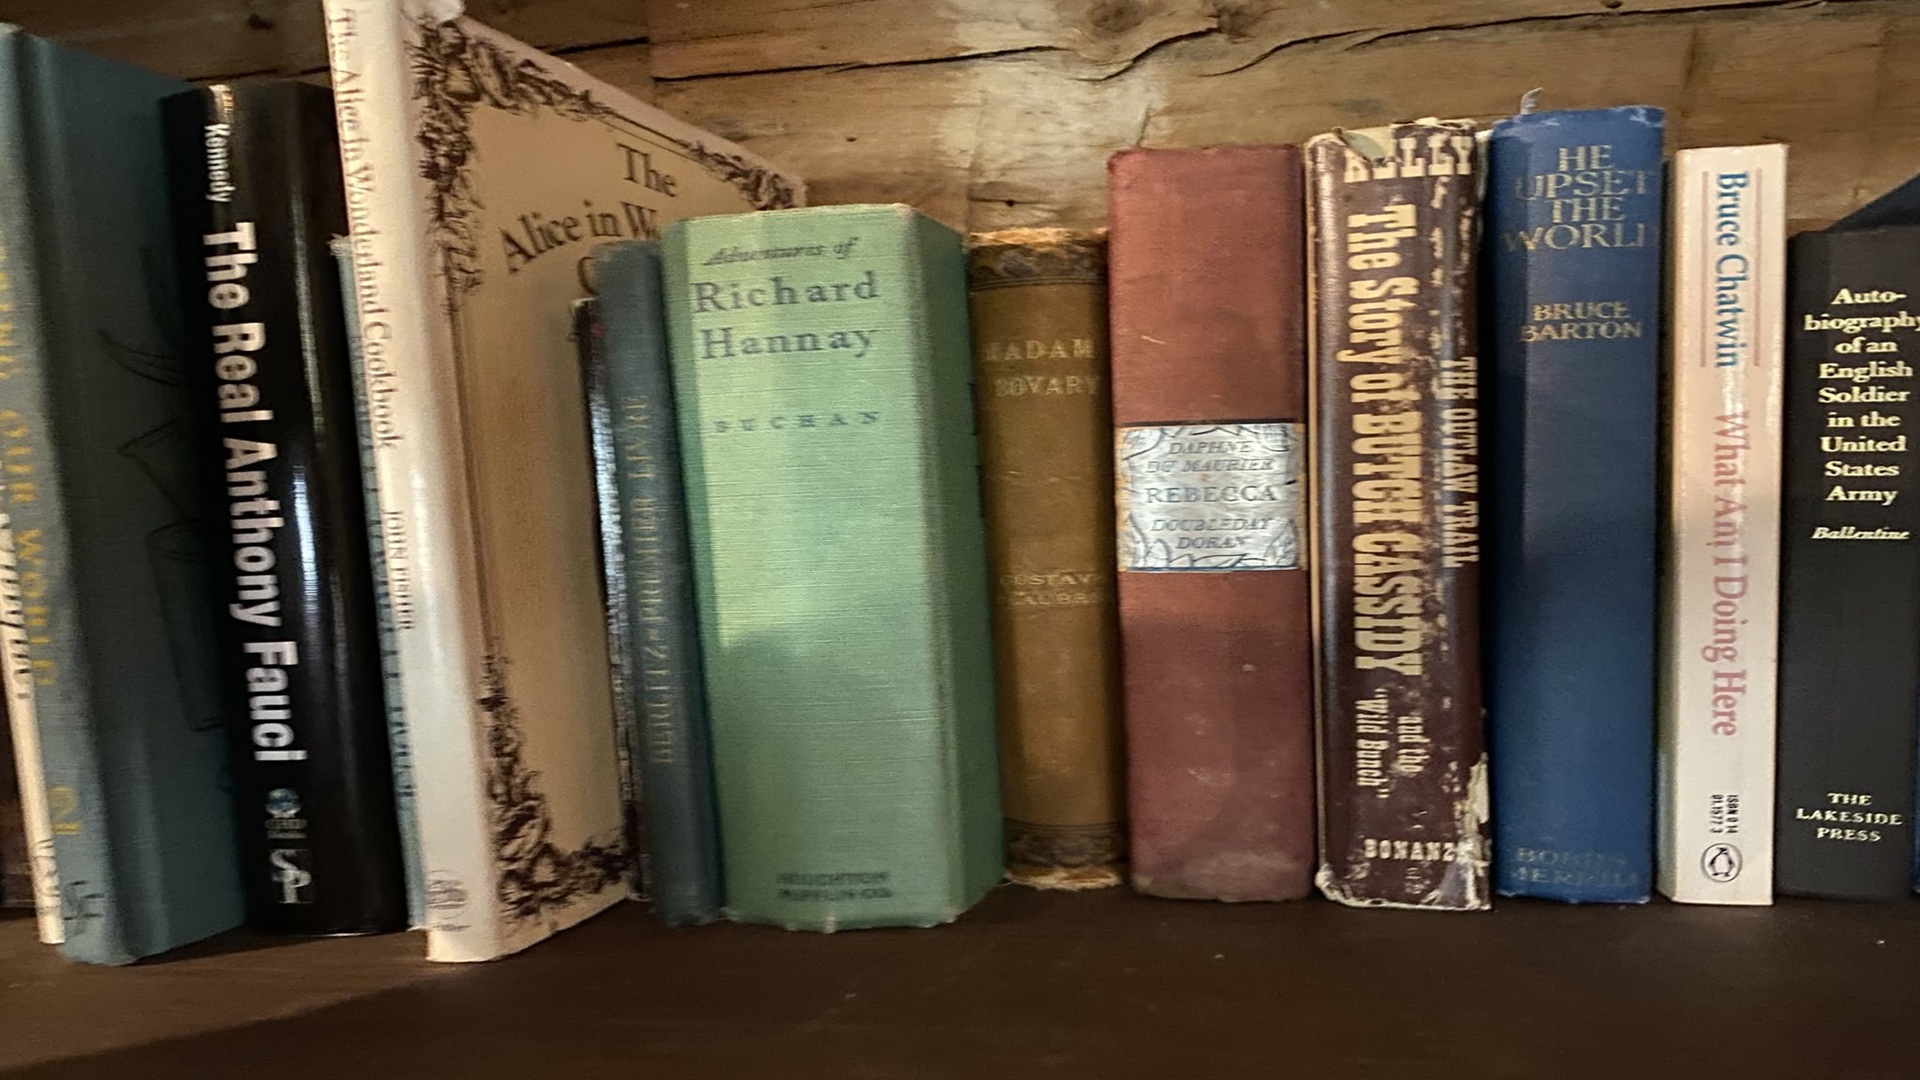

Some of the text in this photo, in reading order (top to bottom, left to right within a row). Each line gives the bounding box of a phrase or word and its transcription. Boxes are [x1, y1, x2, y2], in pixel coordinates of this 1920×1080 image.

[203, 124, 237, 203] Kennedy
[616, 142, 678, 198] The
[1558, 144, 1614, 172] HE
[1545, 196, 1628, 224] THE
[345, 162, 390, 313] Wonderland
[500, 211, 582, 275] Alice
[582, 199, 623, 239] in
[831, 236, 861, 260] of
[1347, 204, 1417, 270] The
[202, 221, 259, 311] The
[1714, 170, 1750, 369] Bruce Chatwin
[690, 270, 881, 314] Richard
[1831, 288, 1908, 305] Auto-
[1336, 276, 1420, 365] Story
[1531, 302, 1632, 322] BRUCE
[1804, 311, 1920, 334] biography
[700, 327, 880, 360] Hannay
[1520, 321, 1644, 342] BARTON
[1834, 336, 1899, 354] of an
[211, 322, 275, 424] Real
[1818, 361, 1914, 383] English
[363, 321, 406, 448] Cookbook
[1817, 386, 1912, 404] Soldier
[713, 411, 879, 434] BUCHAN
[1826, 410, 1903, 428] in the
[1168, 440, 1254, 455] DAPHNE
[1820, 435, 1907, 453] United
[1181, 458, 1276, 473] MAURIER
[1351, 411, 1424, 524] BUTCH
[1440, 356, 1480, 568] THE OUTLAW TRAIL
[1824, 460, 1901, 477] States
[1144, 485, 1277, 504] REBECCA
[1825, 485, 1899, 507] Army
[222, 436, 286, 628] Anthony
[1150, 517, 1275, 532] DOUBLEDAY
[1811, 525, 1912, 540] Ballentine
[1175, 536, 1252, 550] DORAN
[1701, 411, 1751, 737] What Am I Doing Here
[1352, 532, 1424, 676] CASSIDY
[242, 640, 309, 761] Fauci
[1397, 716, 1431, 772] and the
[1827, 792, 1873, 806] THE
[1794, 807, 1903, 826] LAKESIDE
[1816, 827, 1882, 842] PRESS
[1364, 838, 1457, 862] BONANZ
